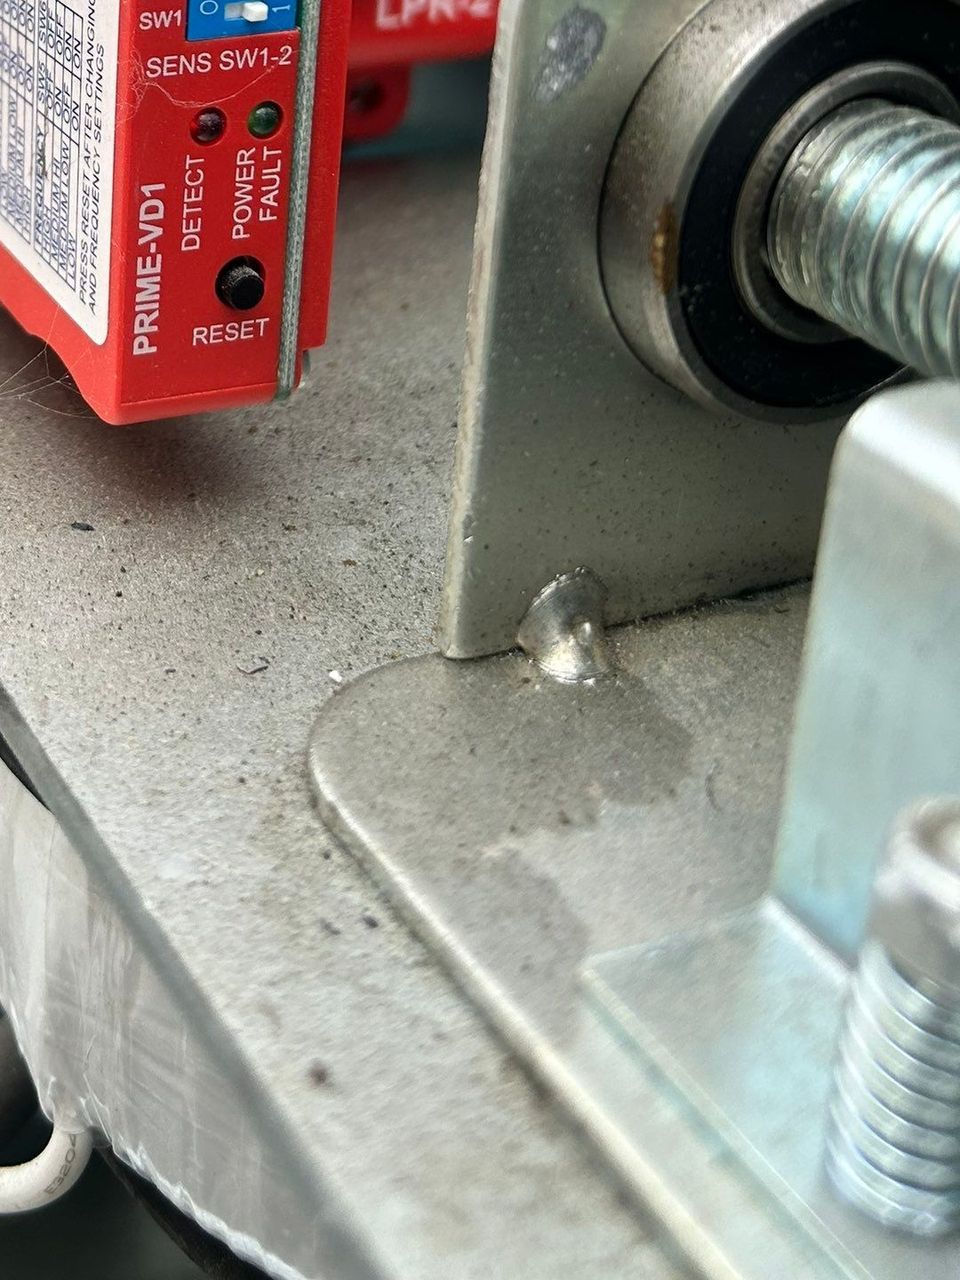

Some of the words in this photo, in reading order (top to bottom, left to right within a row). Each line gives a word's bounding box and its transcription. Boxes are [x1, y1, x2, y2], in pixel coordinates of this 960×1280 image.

[26, 3, 34, 34] ON
[38, 0, 46, 44] SW6
[139, 10, 183, 30] SW1
[272, 4, 290, 14] 1
[55, 14, 63, 56] OFF
[64, 31, 72, 62] ON
[72, 37, 80, 69] ON
[10, 51, 17, 81] ON
[25, 64, 33, 94] ON
[37, 61, 45, 104] SW5
[147, 51, 211, 78] SENS
[219, 45, 292, 71] SW1-2
[54, 87, 62, 118] ON
[62, 83, 71, 125] OFF
[93, 42, 104, 143] SETTINGS
[71, 100, 79, 132] ON
[83, 103, 93, 168] AFTER
[34, 125, 43, 246] FREQUENCY
[53, 158, 60, 178] HI
[61, 141, 69, 187] LOW
[260, 146, 283, 222] FAULT
[81, 171, 90, 236] RESET
[90, 147, 101, 270] FREQUENCY
[181, 154, 205, 251] DETECT
[233, 147, 256, 240] POWER
[51, 183, 60, 262] MEDIUM
[59, 191, 68, 271] MEDIUM
[67, 233, 75, 280] LOW
[79, 239, 88, 306] PRESS
[133, 182, 166, 355] PRIME-VD1
[89, 272, 97, 316] AND
[192, 318, 270, 346] RESET
